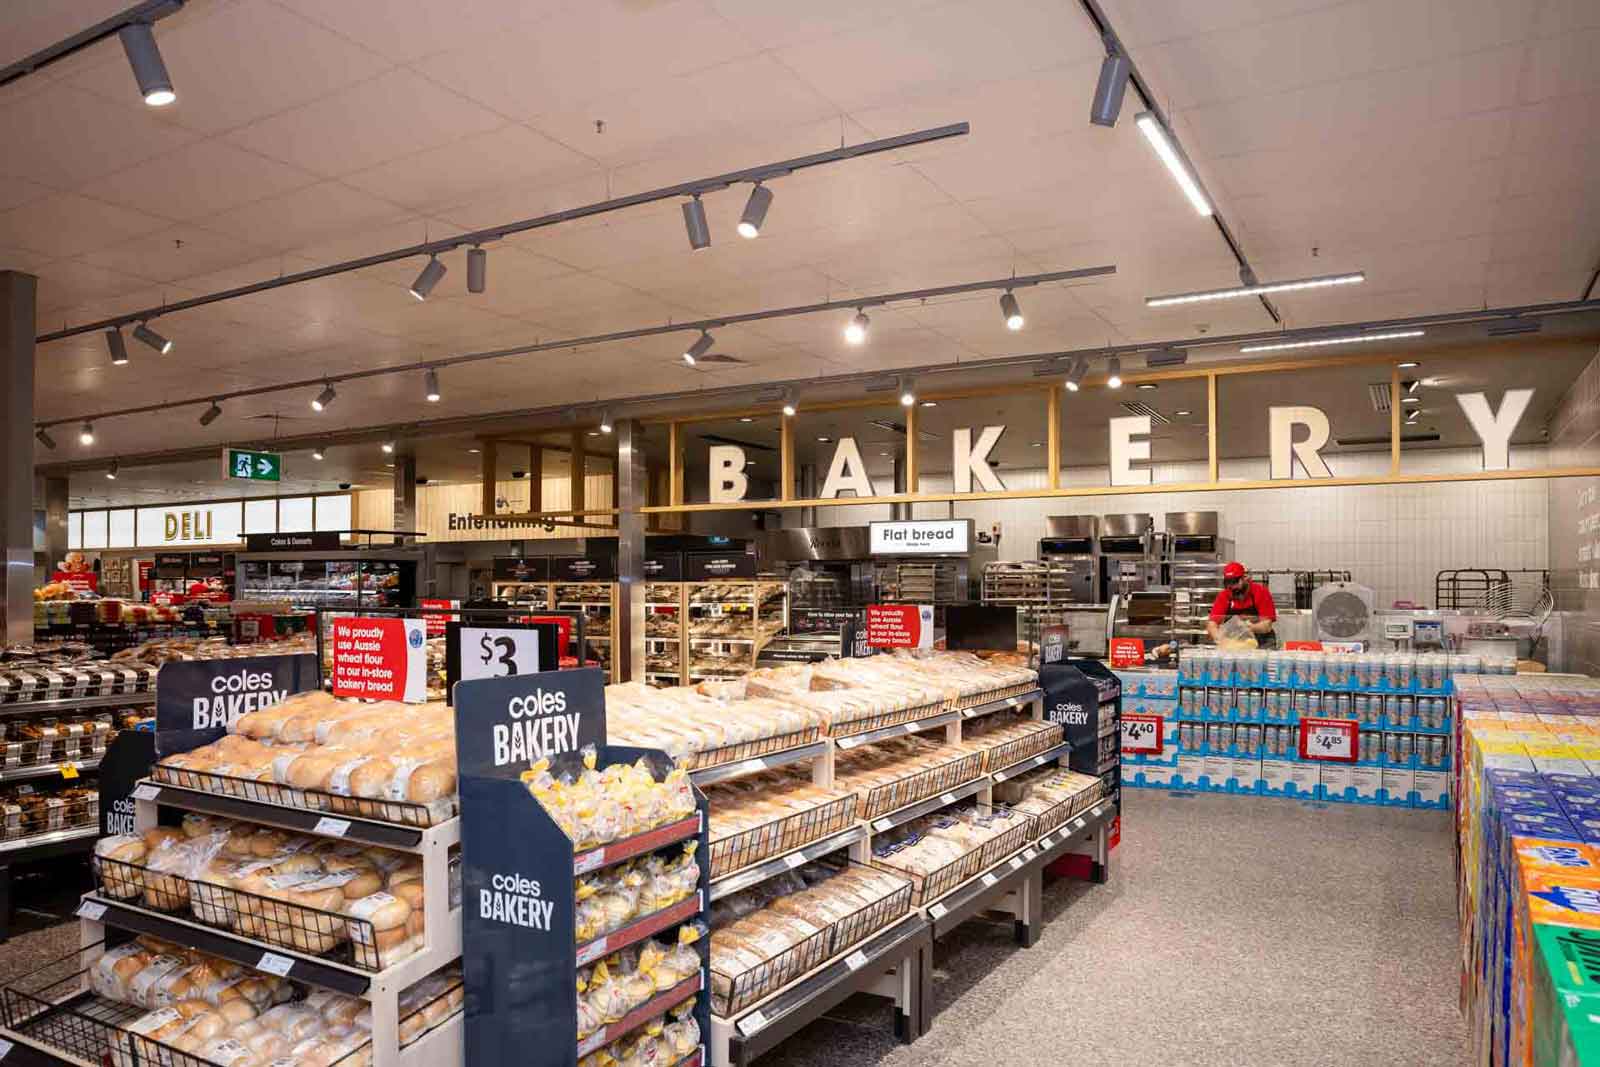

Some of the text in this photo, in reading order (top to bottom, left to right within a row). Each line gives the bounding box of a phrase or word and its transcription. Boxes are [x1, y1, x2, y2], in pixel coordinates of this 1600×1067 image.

[710, 389, 1536, 503] BAKERY
[165, 511, 213, 541] DELI
[883, 527, 954, 540] Flat bread
[338, 626, 384, 640] We proudly
[337, 640, 381, 651] use Aussie
[337, 652, 384, 665] wheat flour
[480, 631, 518, 677] $3
[337, 664, 393, 679] in our in-store
[211, 669, 273, 693] coles
[337, 678, 393, 692] bakery bread
[508, 688, 566, 719] coles
[1056, 701, 1082, 712] coles
[1049, 710, 1088, 725] BAKERY
[493, 712, 580, 766] BAKERY
[113, 798, 136, 814] cole
[492, 873, 541, 897] coles
[480, 889, 554, 931] BAKERY
